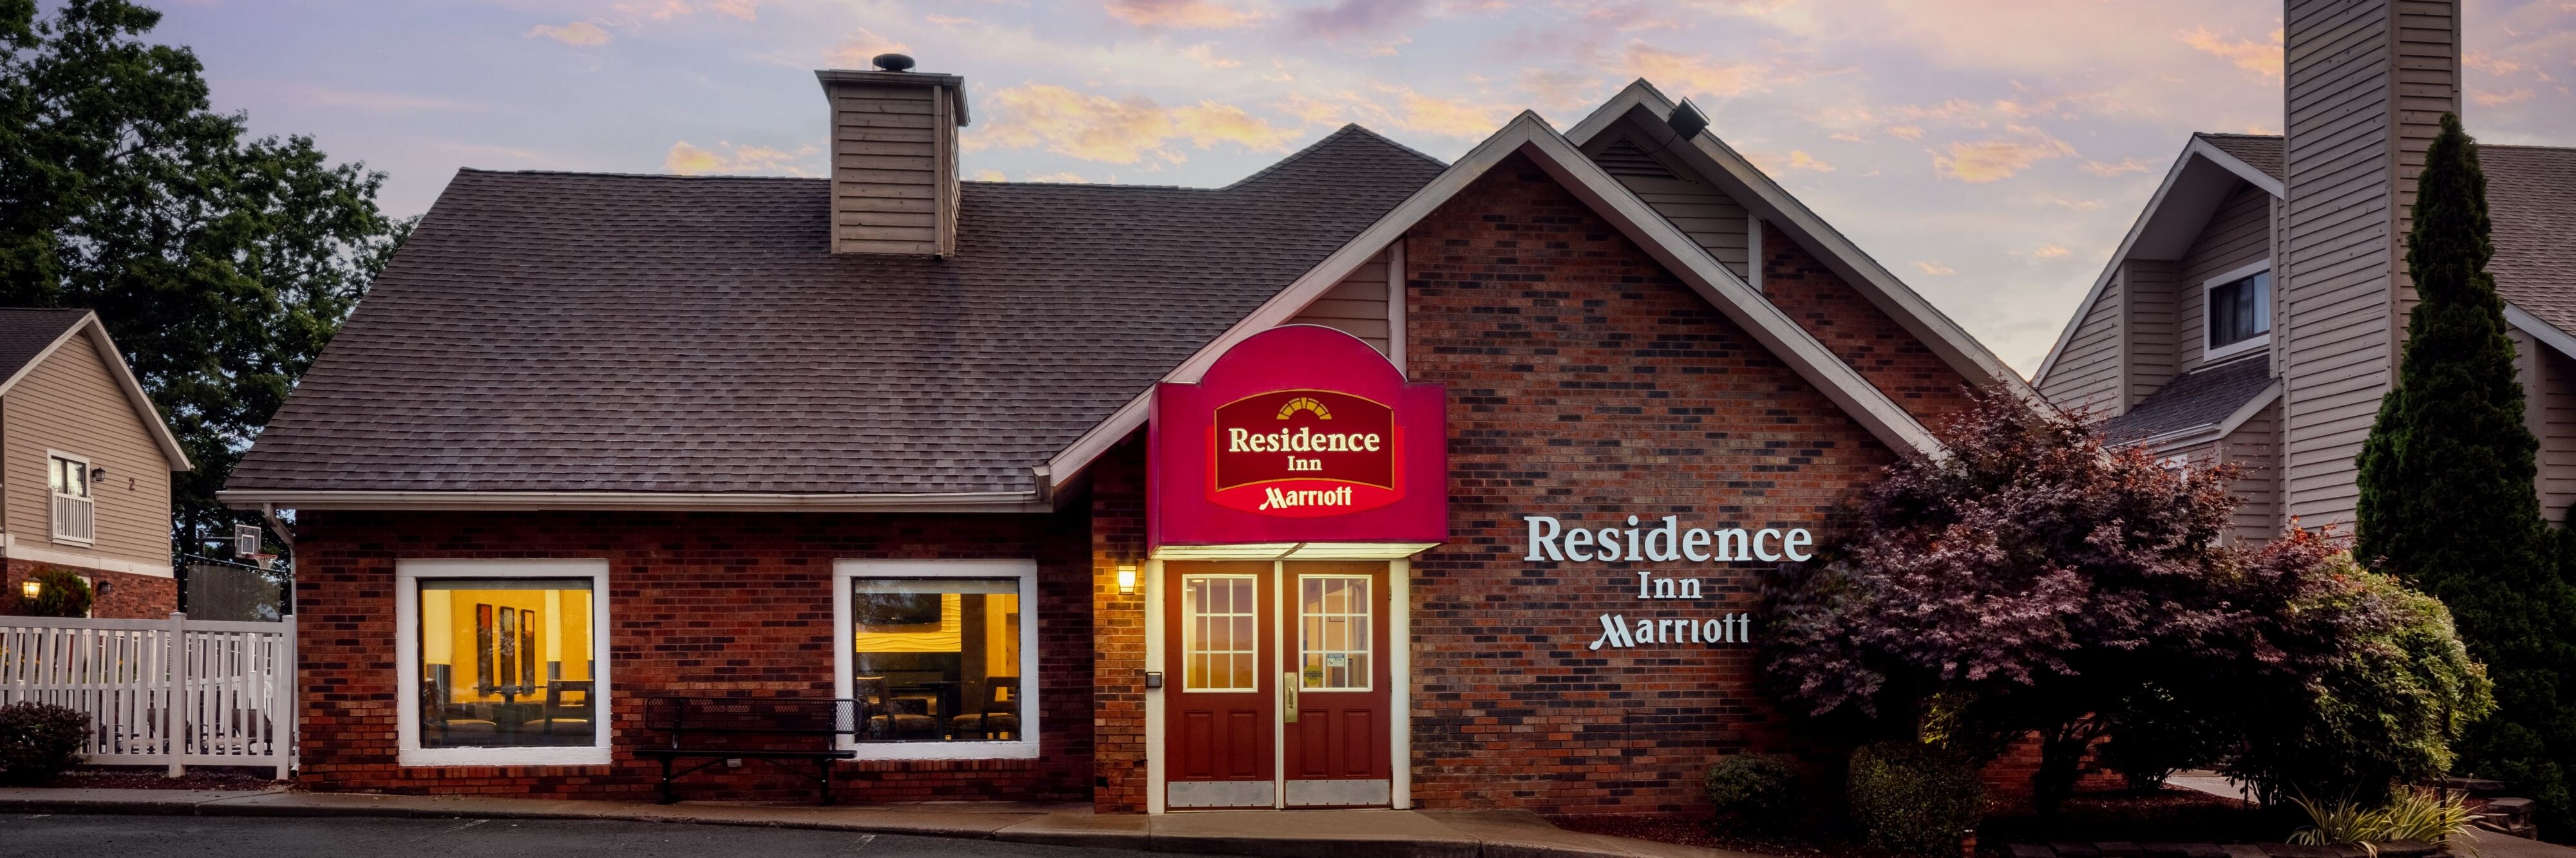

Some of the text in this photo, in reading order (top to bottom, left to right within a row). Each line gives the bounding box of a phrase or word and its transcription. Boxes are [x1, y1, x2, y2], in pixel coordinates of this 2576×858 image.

[1229, 427, 1379, 452] Residence
[1287, 456, 1322, 471] Inn
[129, 477, 135, 490] 2
[1259, 487, 1352, 510] Marriott
[1524, 515, 1812, 562] Residence
[1638, 572, 1702, 599] Inn
[1589, 613, 1750, 650] Marriott
